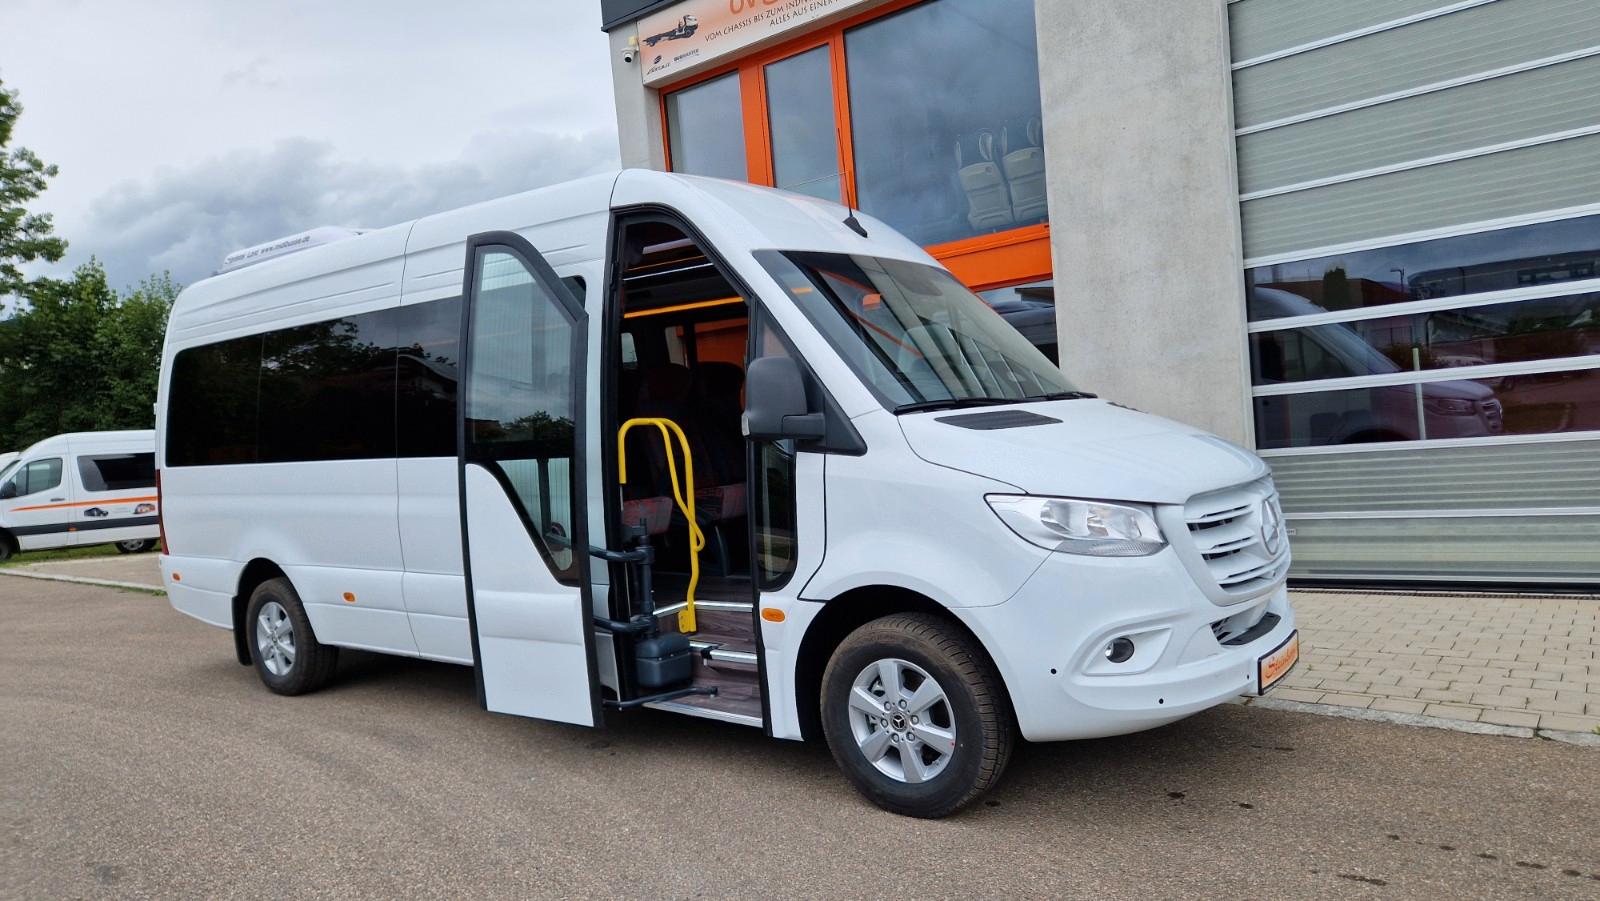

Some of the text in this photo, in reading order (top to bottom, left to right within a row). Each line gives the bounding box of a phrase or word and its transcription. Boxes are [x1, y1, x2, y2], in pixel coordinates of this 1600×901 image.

[705, 30, 722, 42] VOM
[723, 17, 752, 35] CHASSIS
[753, 12, 764, 23] BIS
[765, 5, 784, 19] ZUM
[769, 13, 791, 27] ALLES
[792, 6, 808, 19] AUS
